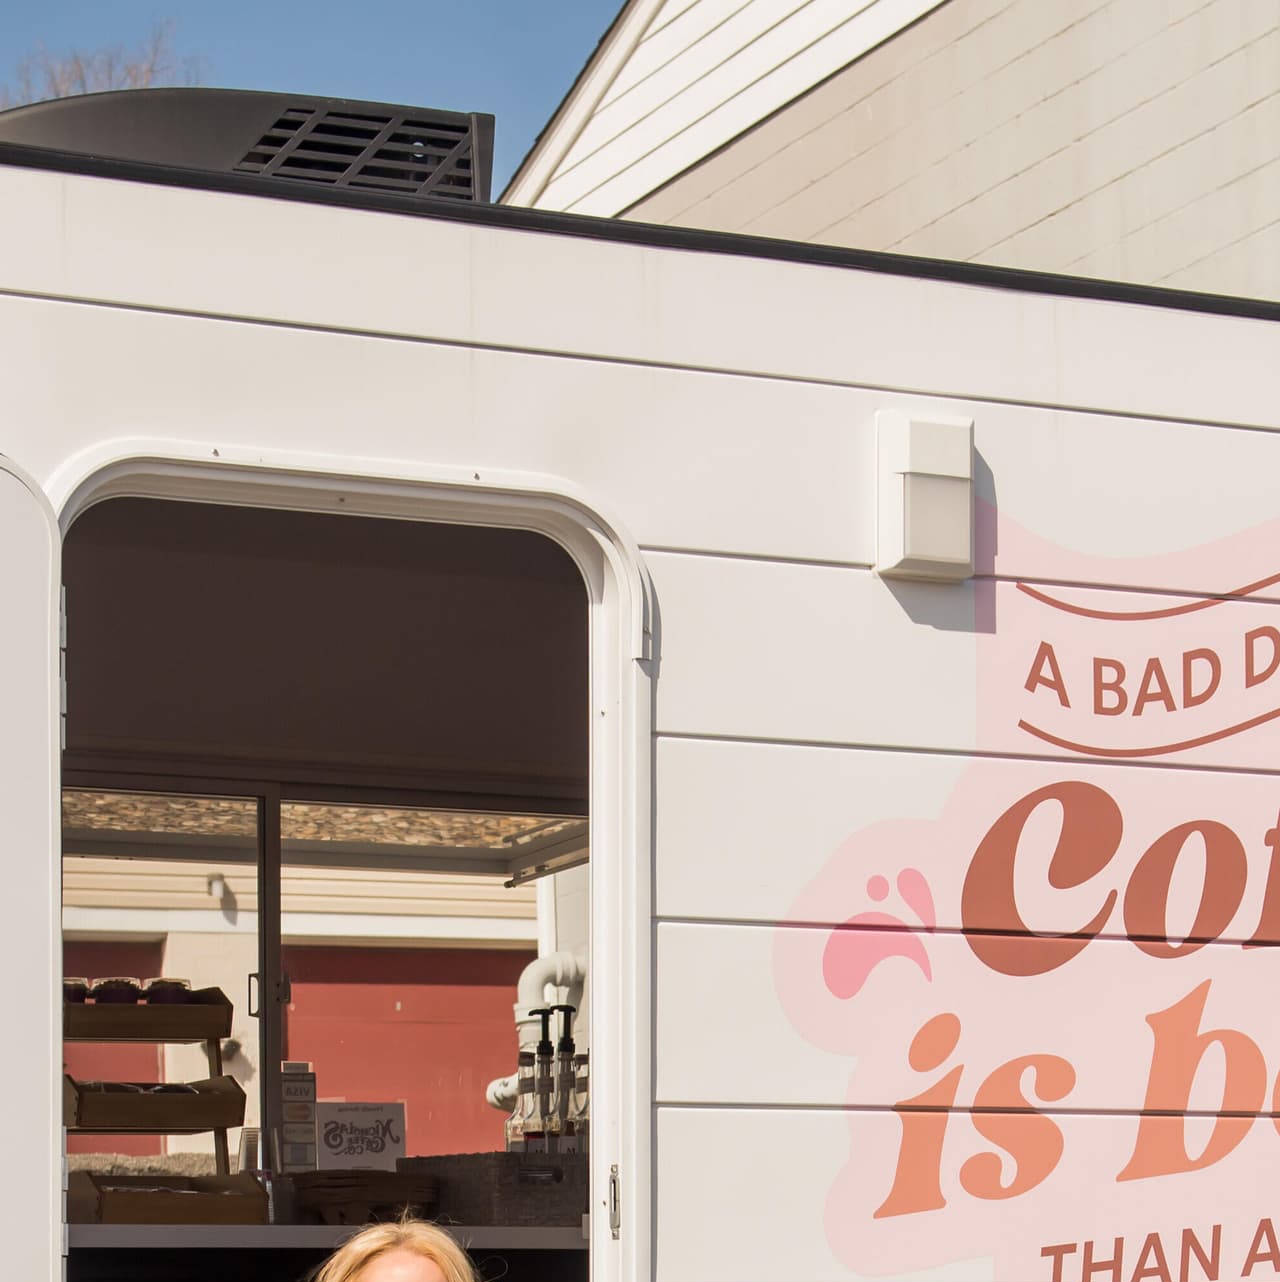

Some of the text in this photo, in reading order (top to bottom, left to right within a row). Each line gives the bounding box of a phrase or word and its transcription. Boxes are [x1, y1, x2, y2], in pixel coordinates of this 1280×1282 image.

[1023, 640, 1072, 709] A
[1092, 647, 1223, 718] BAD
[872, 1012, 1077, 1221] is
